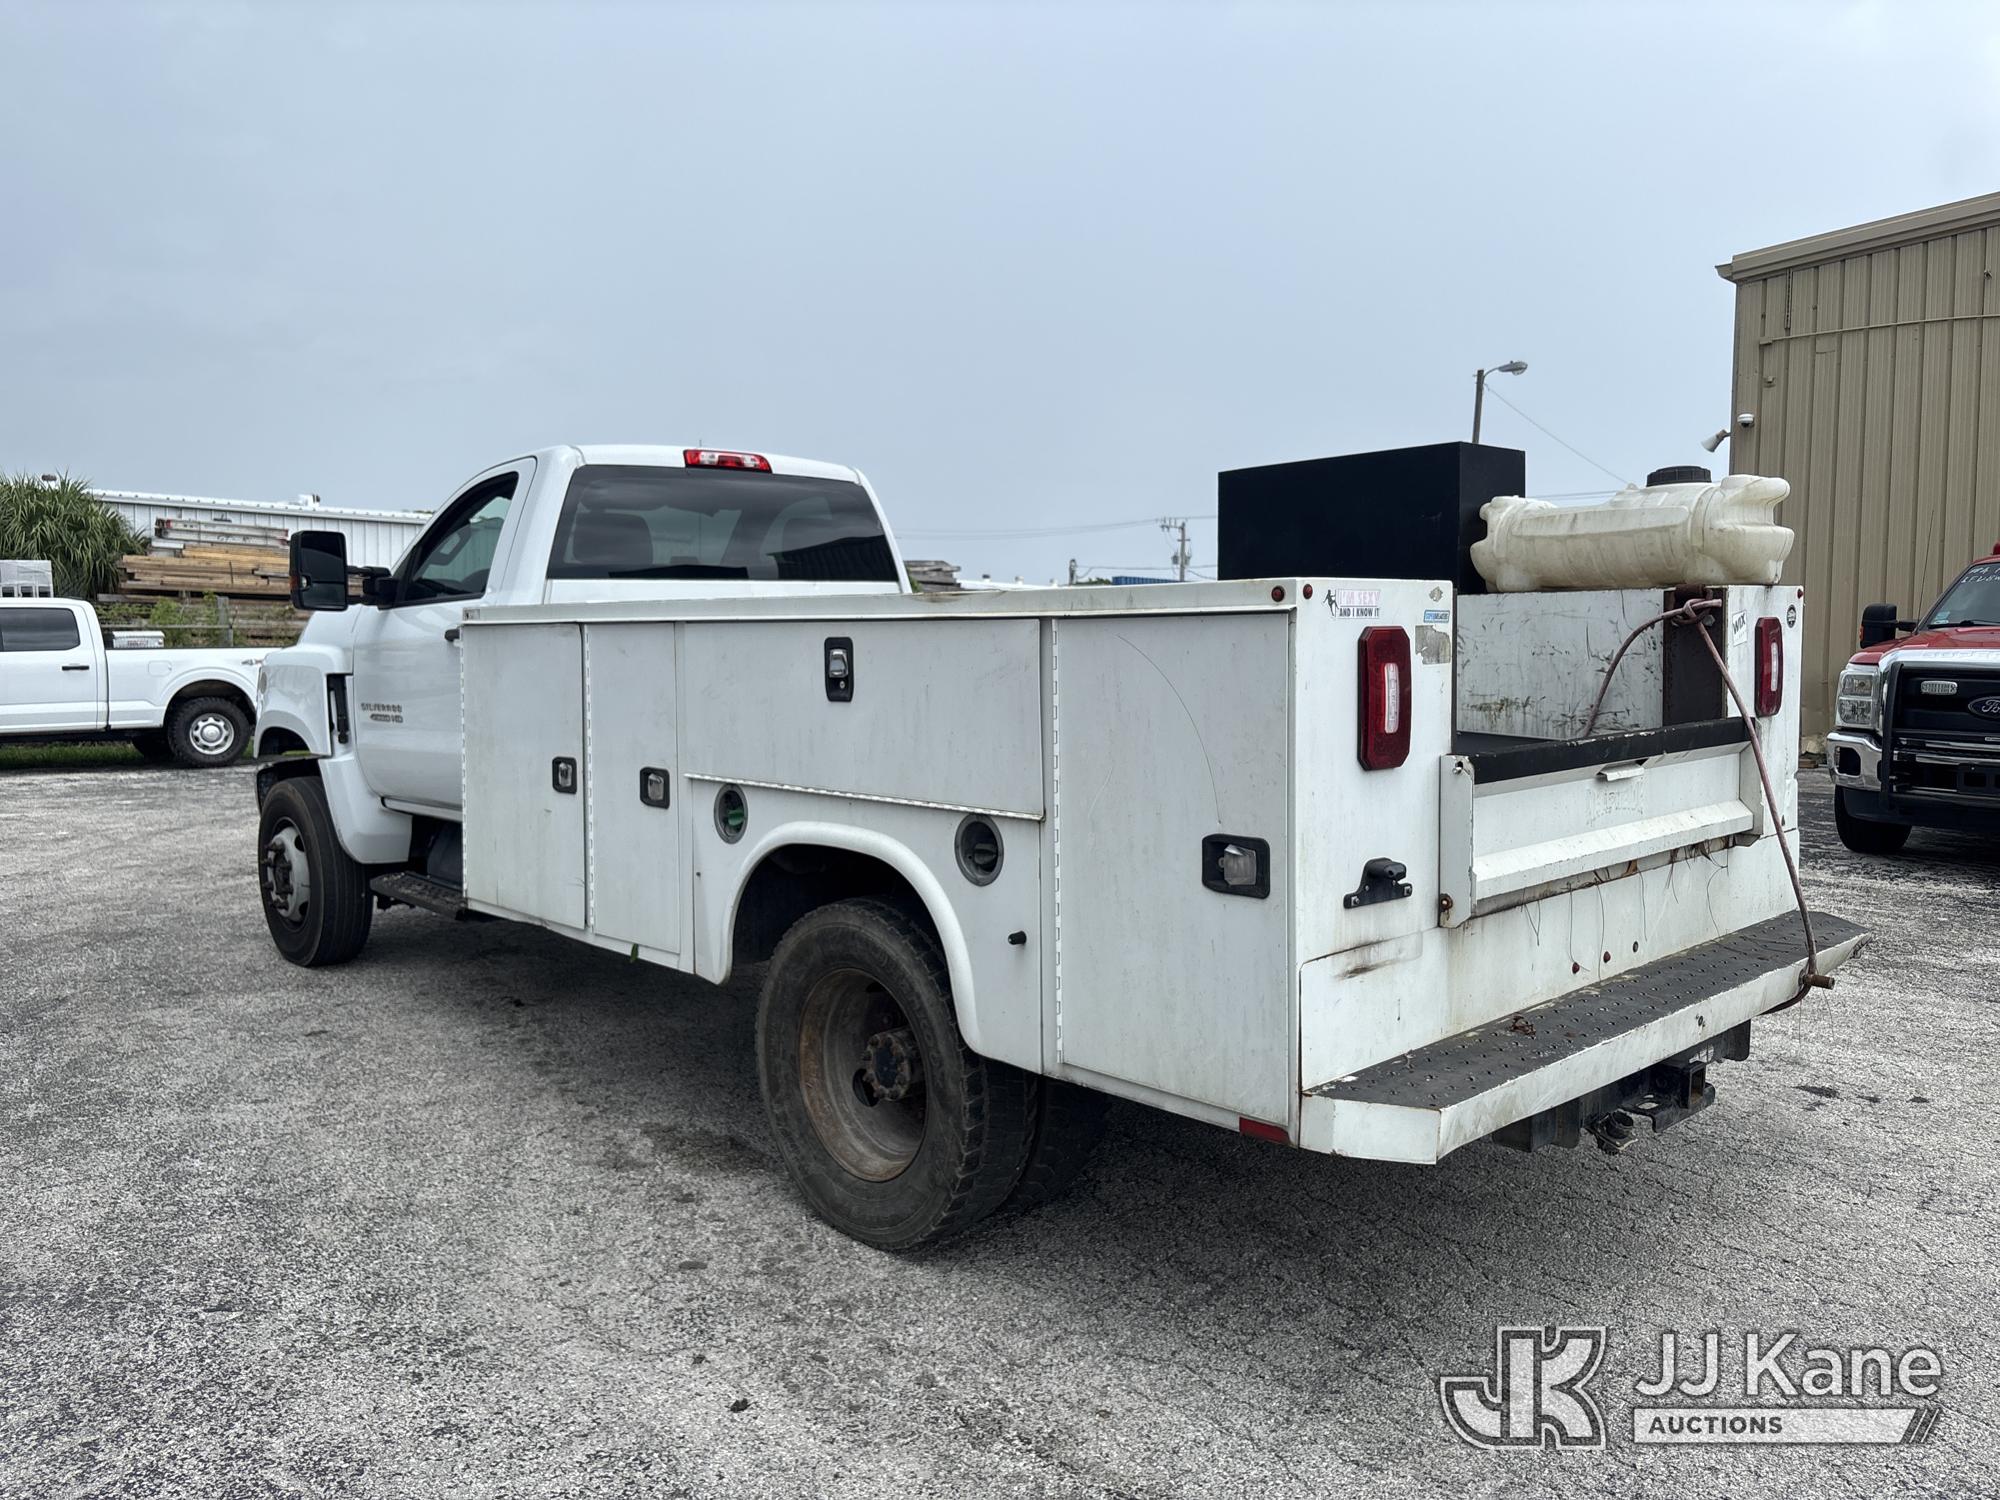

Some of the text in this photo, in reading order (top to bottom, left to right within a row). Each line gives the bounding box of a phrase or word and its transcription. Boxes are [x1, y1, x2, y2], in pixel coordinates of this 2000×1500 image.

[1358, 591, 1381, 605] SEXY
[1339, 607, 1351, 617] AND
[1356, 607, 1373, 617] KNOW
[1374, 607, 1379, 617] IT
[1732, 612, 1746, 635] WIX
